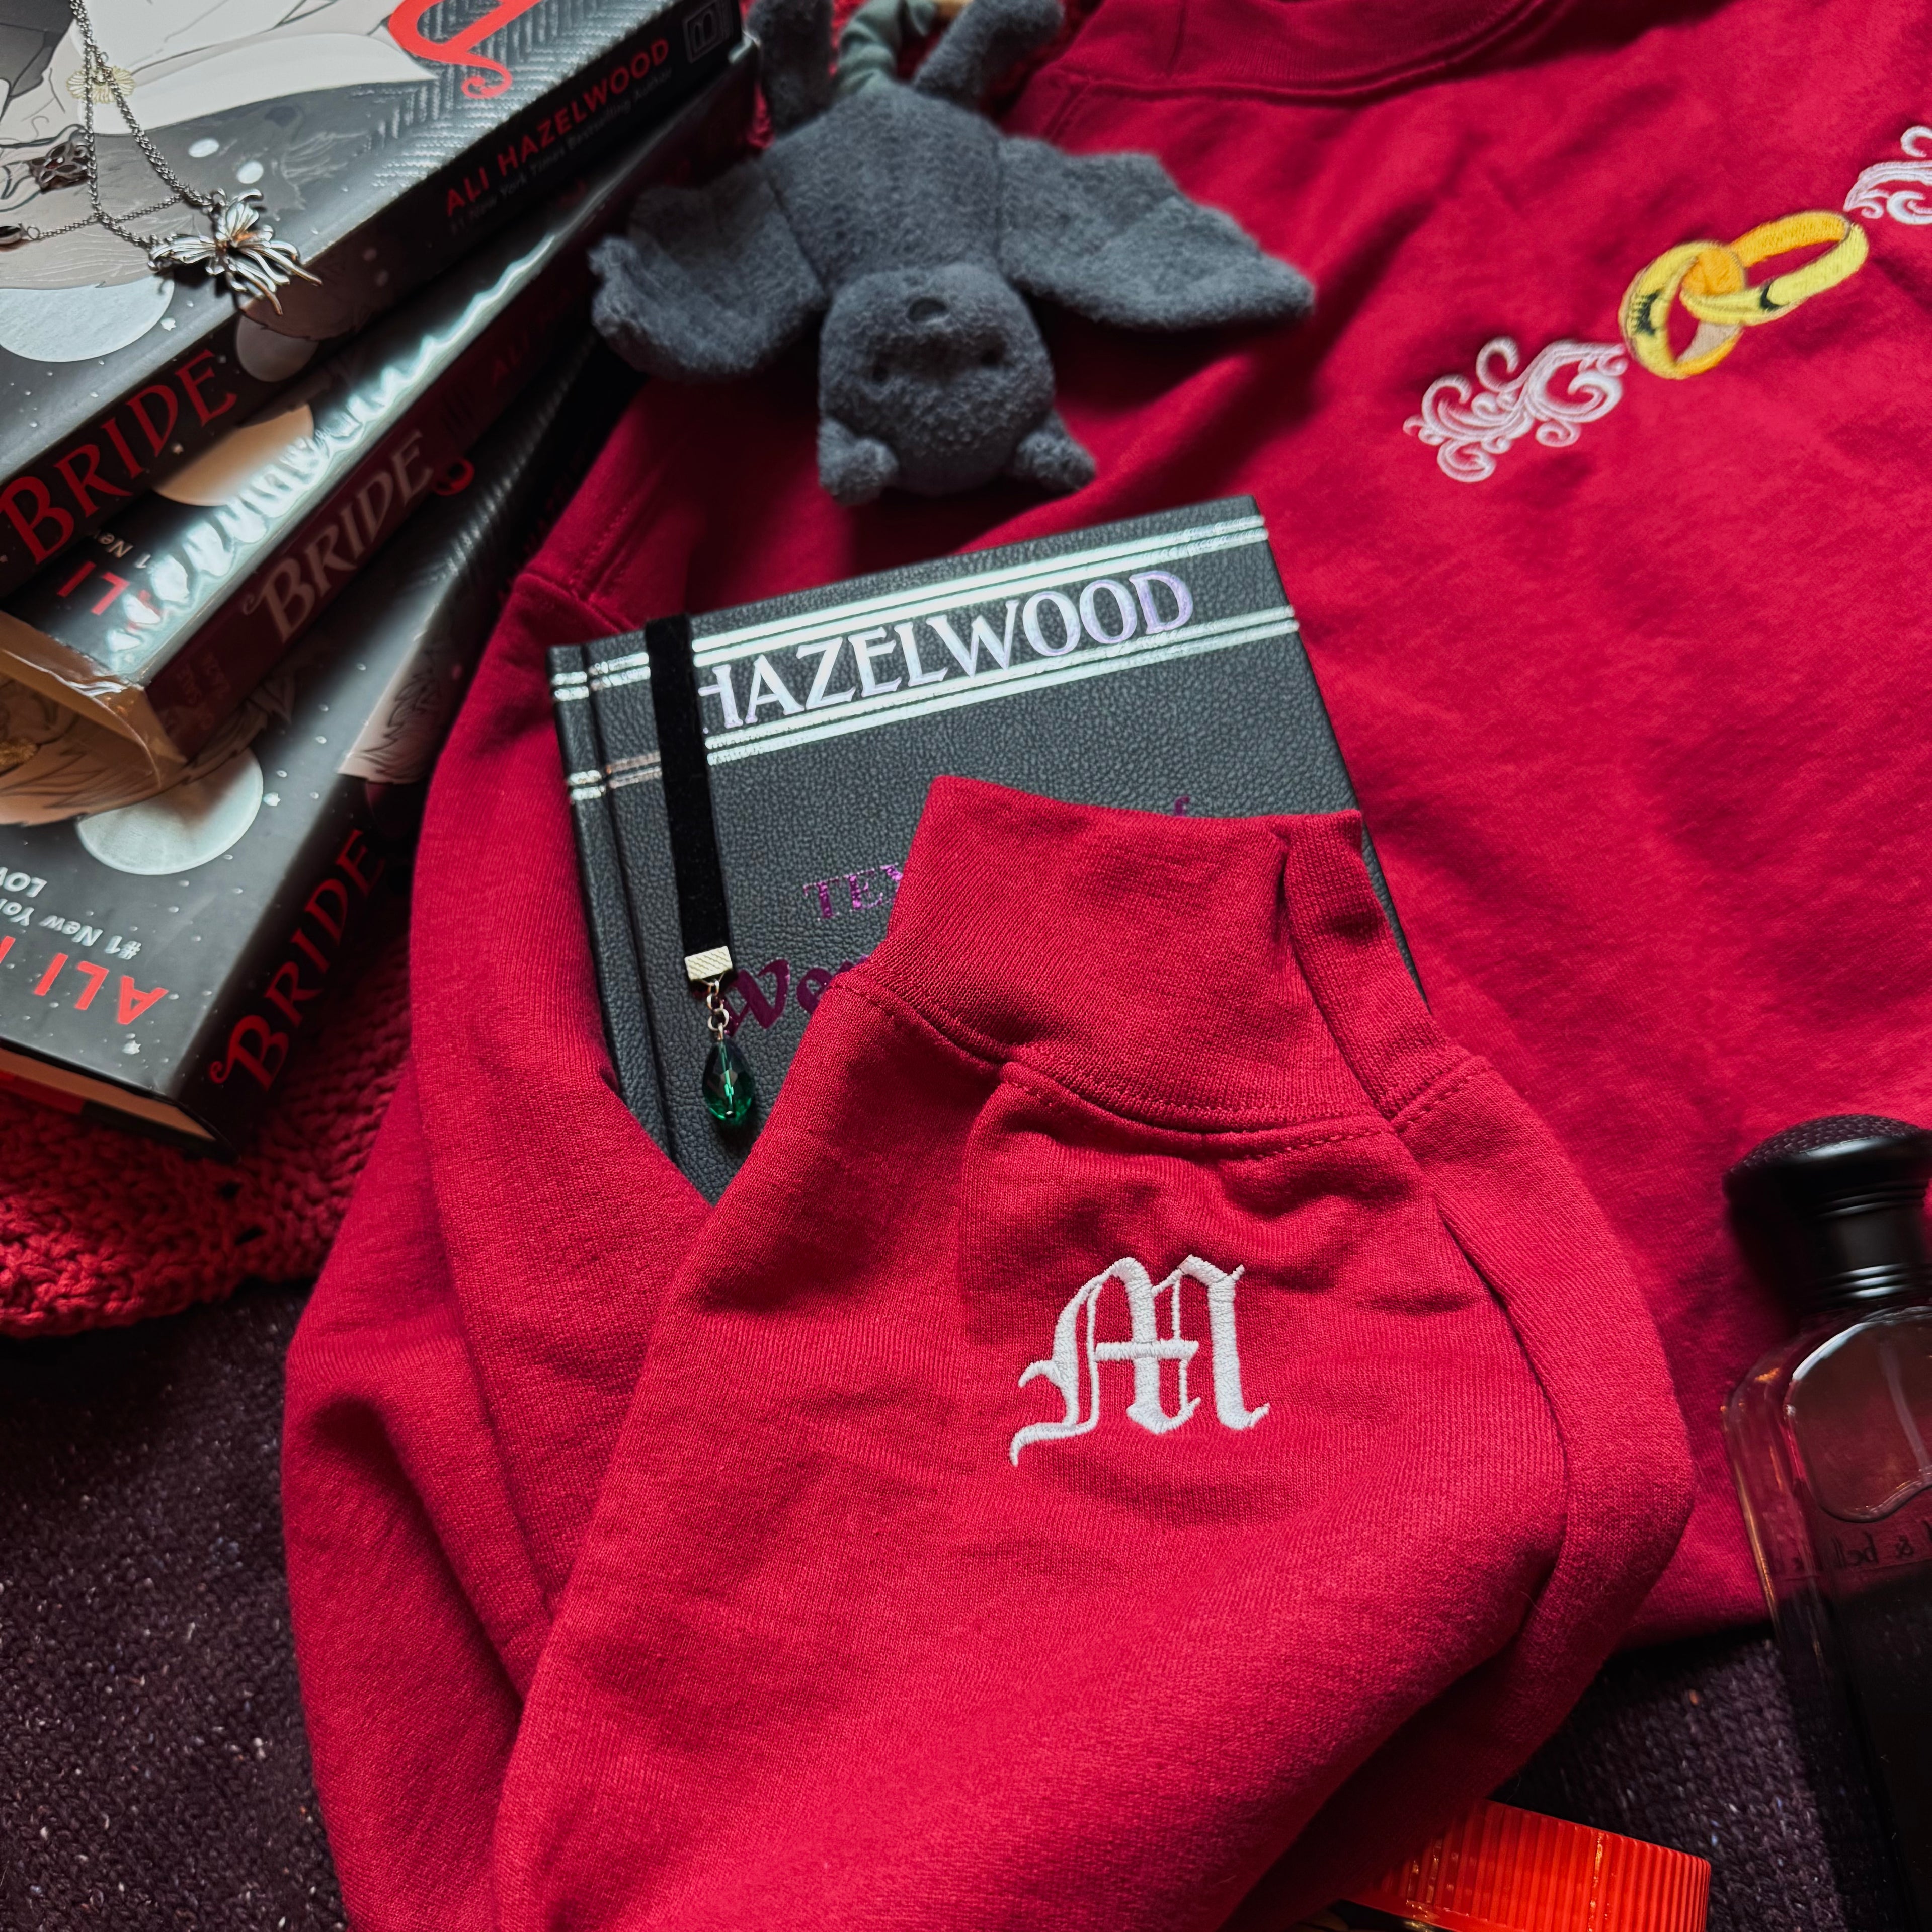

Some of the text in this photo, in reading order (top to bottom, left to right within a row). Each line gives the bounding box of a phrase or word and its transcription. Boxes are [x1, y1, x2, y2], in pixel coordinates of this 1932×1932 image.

[446, 167, 489, 217] ALI
[498, 38, 669, 176] HAZELWOOD
[0, 349, 237, 565] BRIDE
[57, 561, 161, 631] LI
[94, 532, 134, 558] Ne
[242, 429, 433, 645] BRIDE
[33, 952, 169, 1025] ALI
[40, 913, 103, 948] New
[105, 935, 142, 961] #1
[210, 829, 385, 1091] BRIDE
[1009, 1254, 1270, 1467] M
